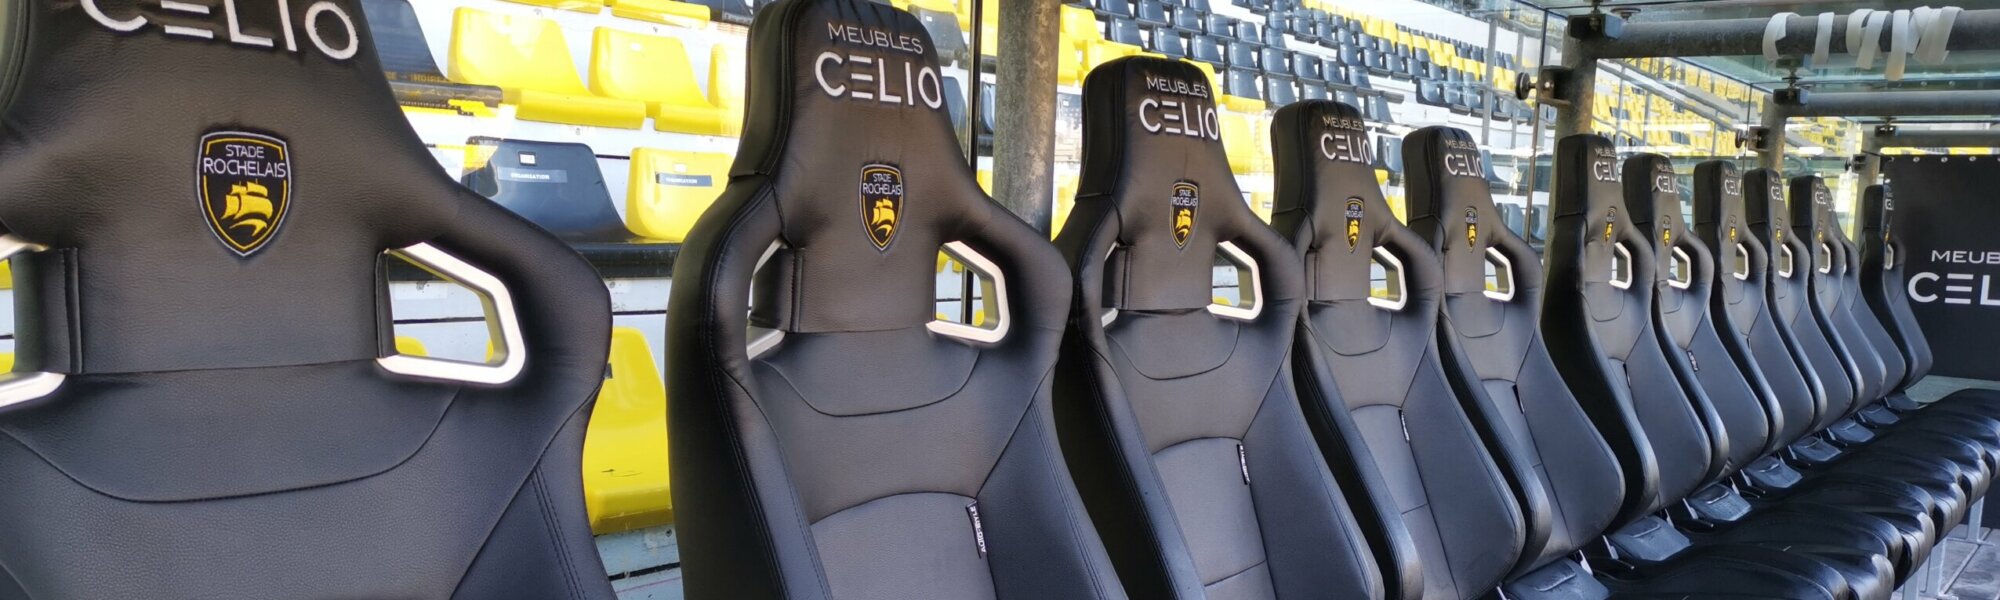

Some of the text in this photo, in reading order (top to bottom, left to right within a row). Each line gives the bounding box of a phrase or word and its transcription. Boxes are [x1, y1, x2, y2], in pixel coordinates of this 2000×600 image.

[80, 0, 358, 59] CELIO
[827, 22, 923, 54] MEUBLES
[815, 51, 942, 109] CELIO
[1146, 76, 1208, 98] MEUBLES
[1139, 98, 1220, 141] CELIO
[1322, 116, 1363, 131] MEUBLES
[225, 144, 264, 158] STADE
[1321, 133, 1371, 165] CELIO
[203, 157, 287, 178] ROCHELAIS
[872, 173, 892, 182] STADE
[863, 182, 901, 195] ROCHELAIS
[1908, 271, 2000, 306] CEL
